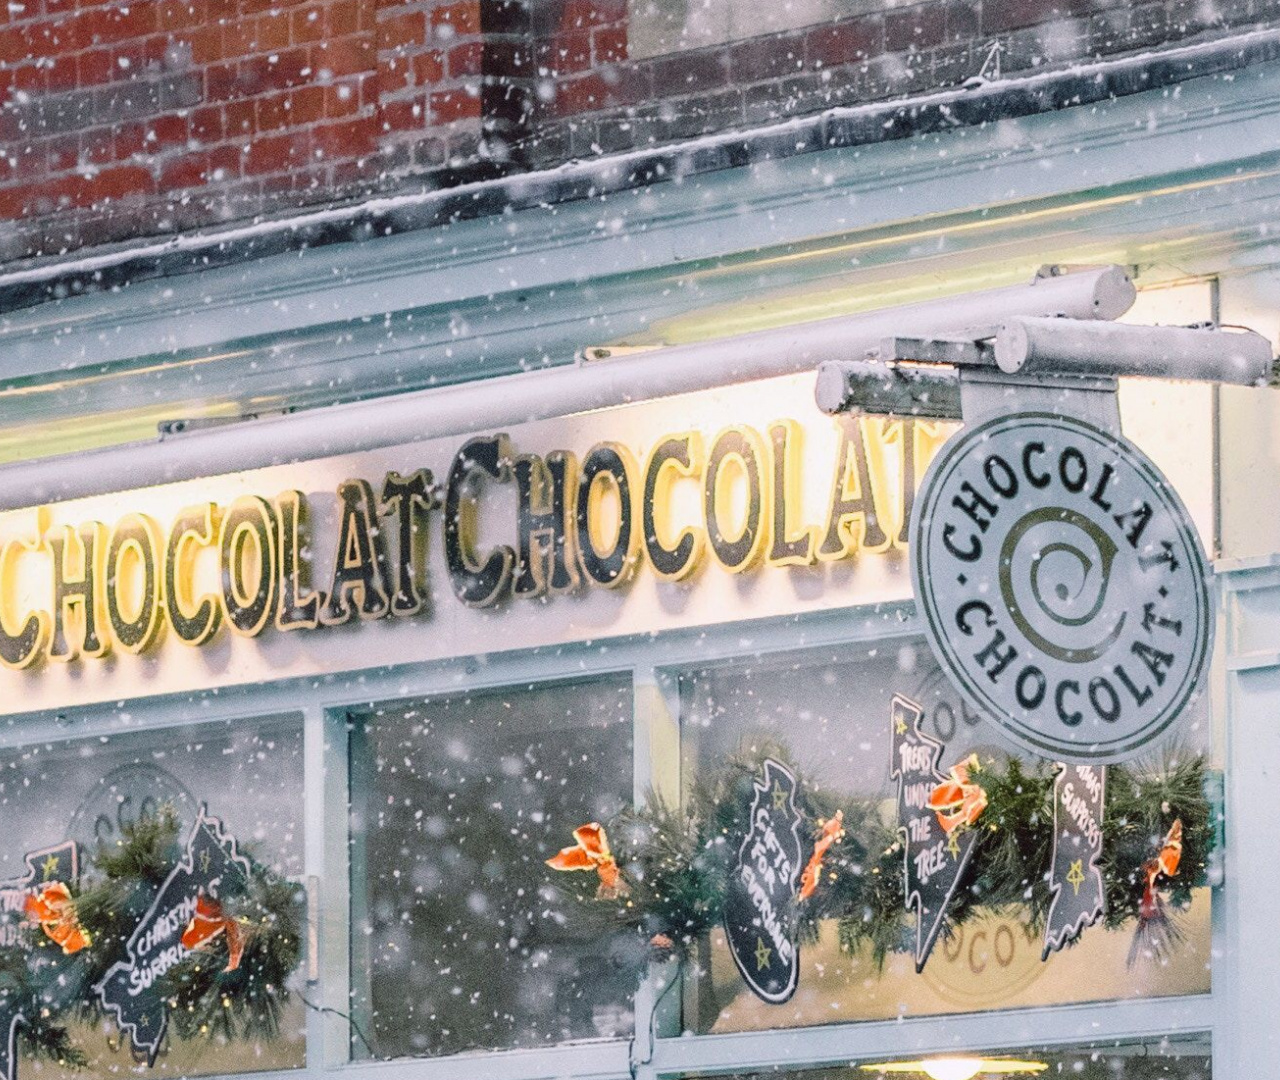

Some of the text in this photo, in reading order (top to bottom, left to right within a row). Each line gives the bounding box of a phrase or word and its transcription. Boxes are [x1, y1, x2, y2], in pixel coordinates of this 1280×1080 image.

[942, 440, 1182, 564] CHOCOLAT
[954, 597, 1184, 727] CHOCOLAT
[908, 815, 932, 843] THE
[914, 839, 947, 881] TREE
[136, 876, 222, 956] CHRISTMS
